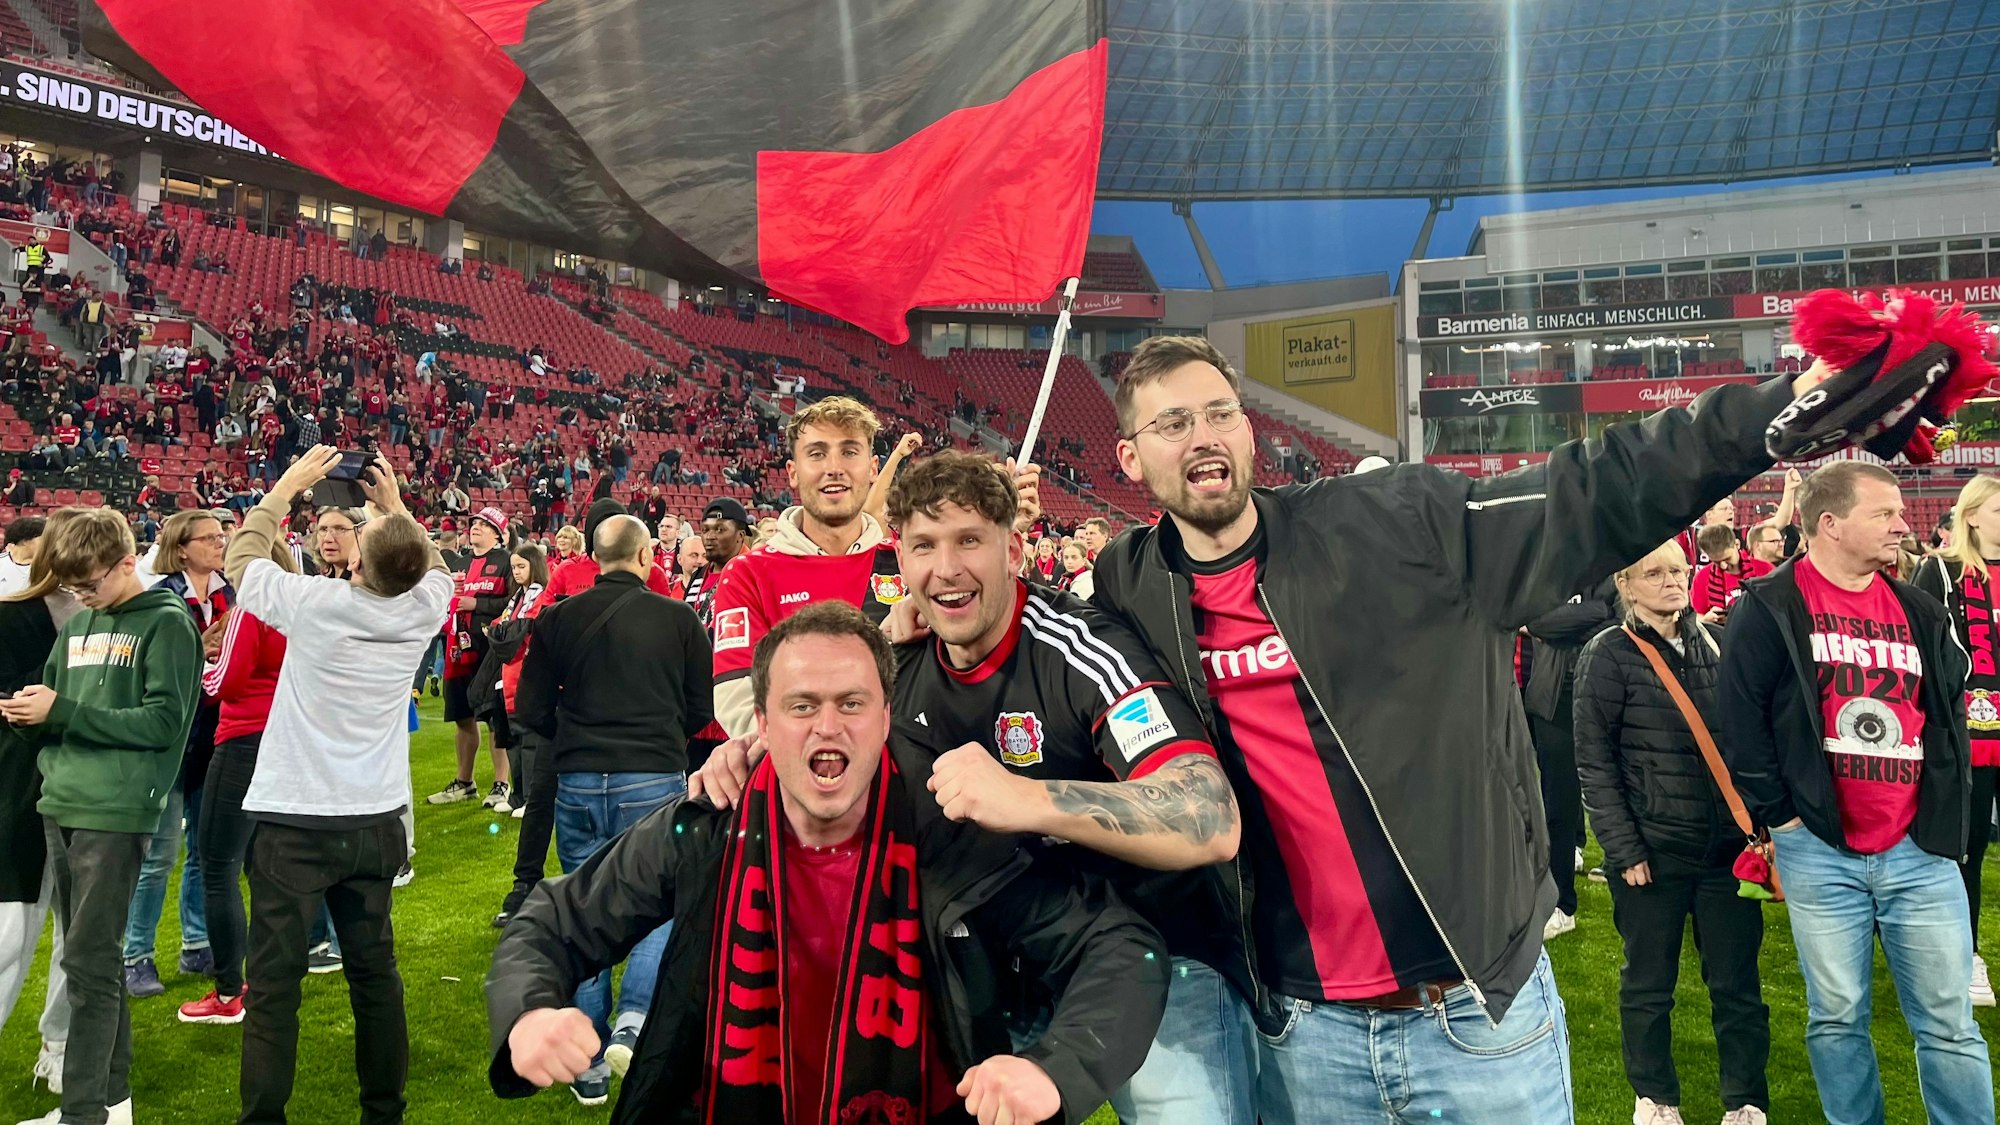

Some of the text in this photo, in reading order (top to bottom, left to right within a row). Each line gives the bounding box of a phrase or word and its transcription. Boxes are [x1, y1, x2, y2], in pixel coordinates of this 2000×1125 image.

[16, 72, 92, 113] SIND
[1438, 305, 1706, 335] Barmenia EINFACH. MENSCHLICH.
[1288, 335, 1347, 354] Plakat-
[1288, 354, 1347, 368] verkauft.de
[1639, 388, 1669, 405] Rudolf
[780, 591, 810, 604] JAKO
[1809, 633, 1922, 677] MEISTER
[1122, 721, 1170, 753] Hermes
